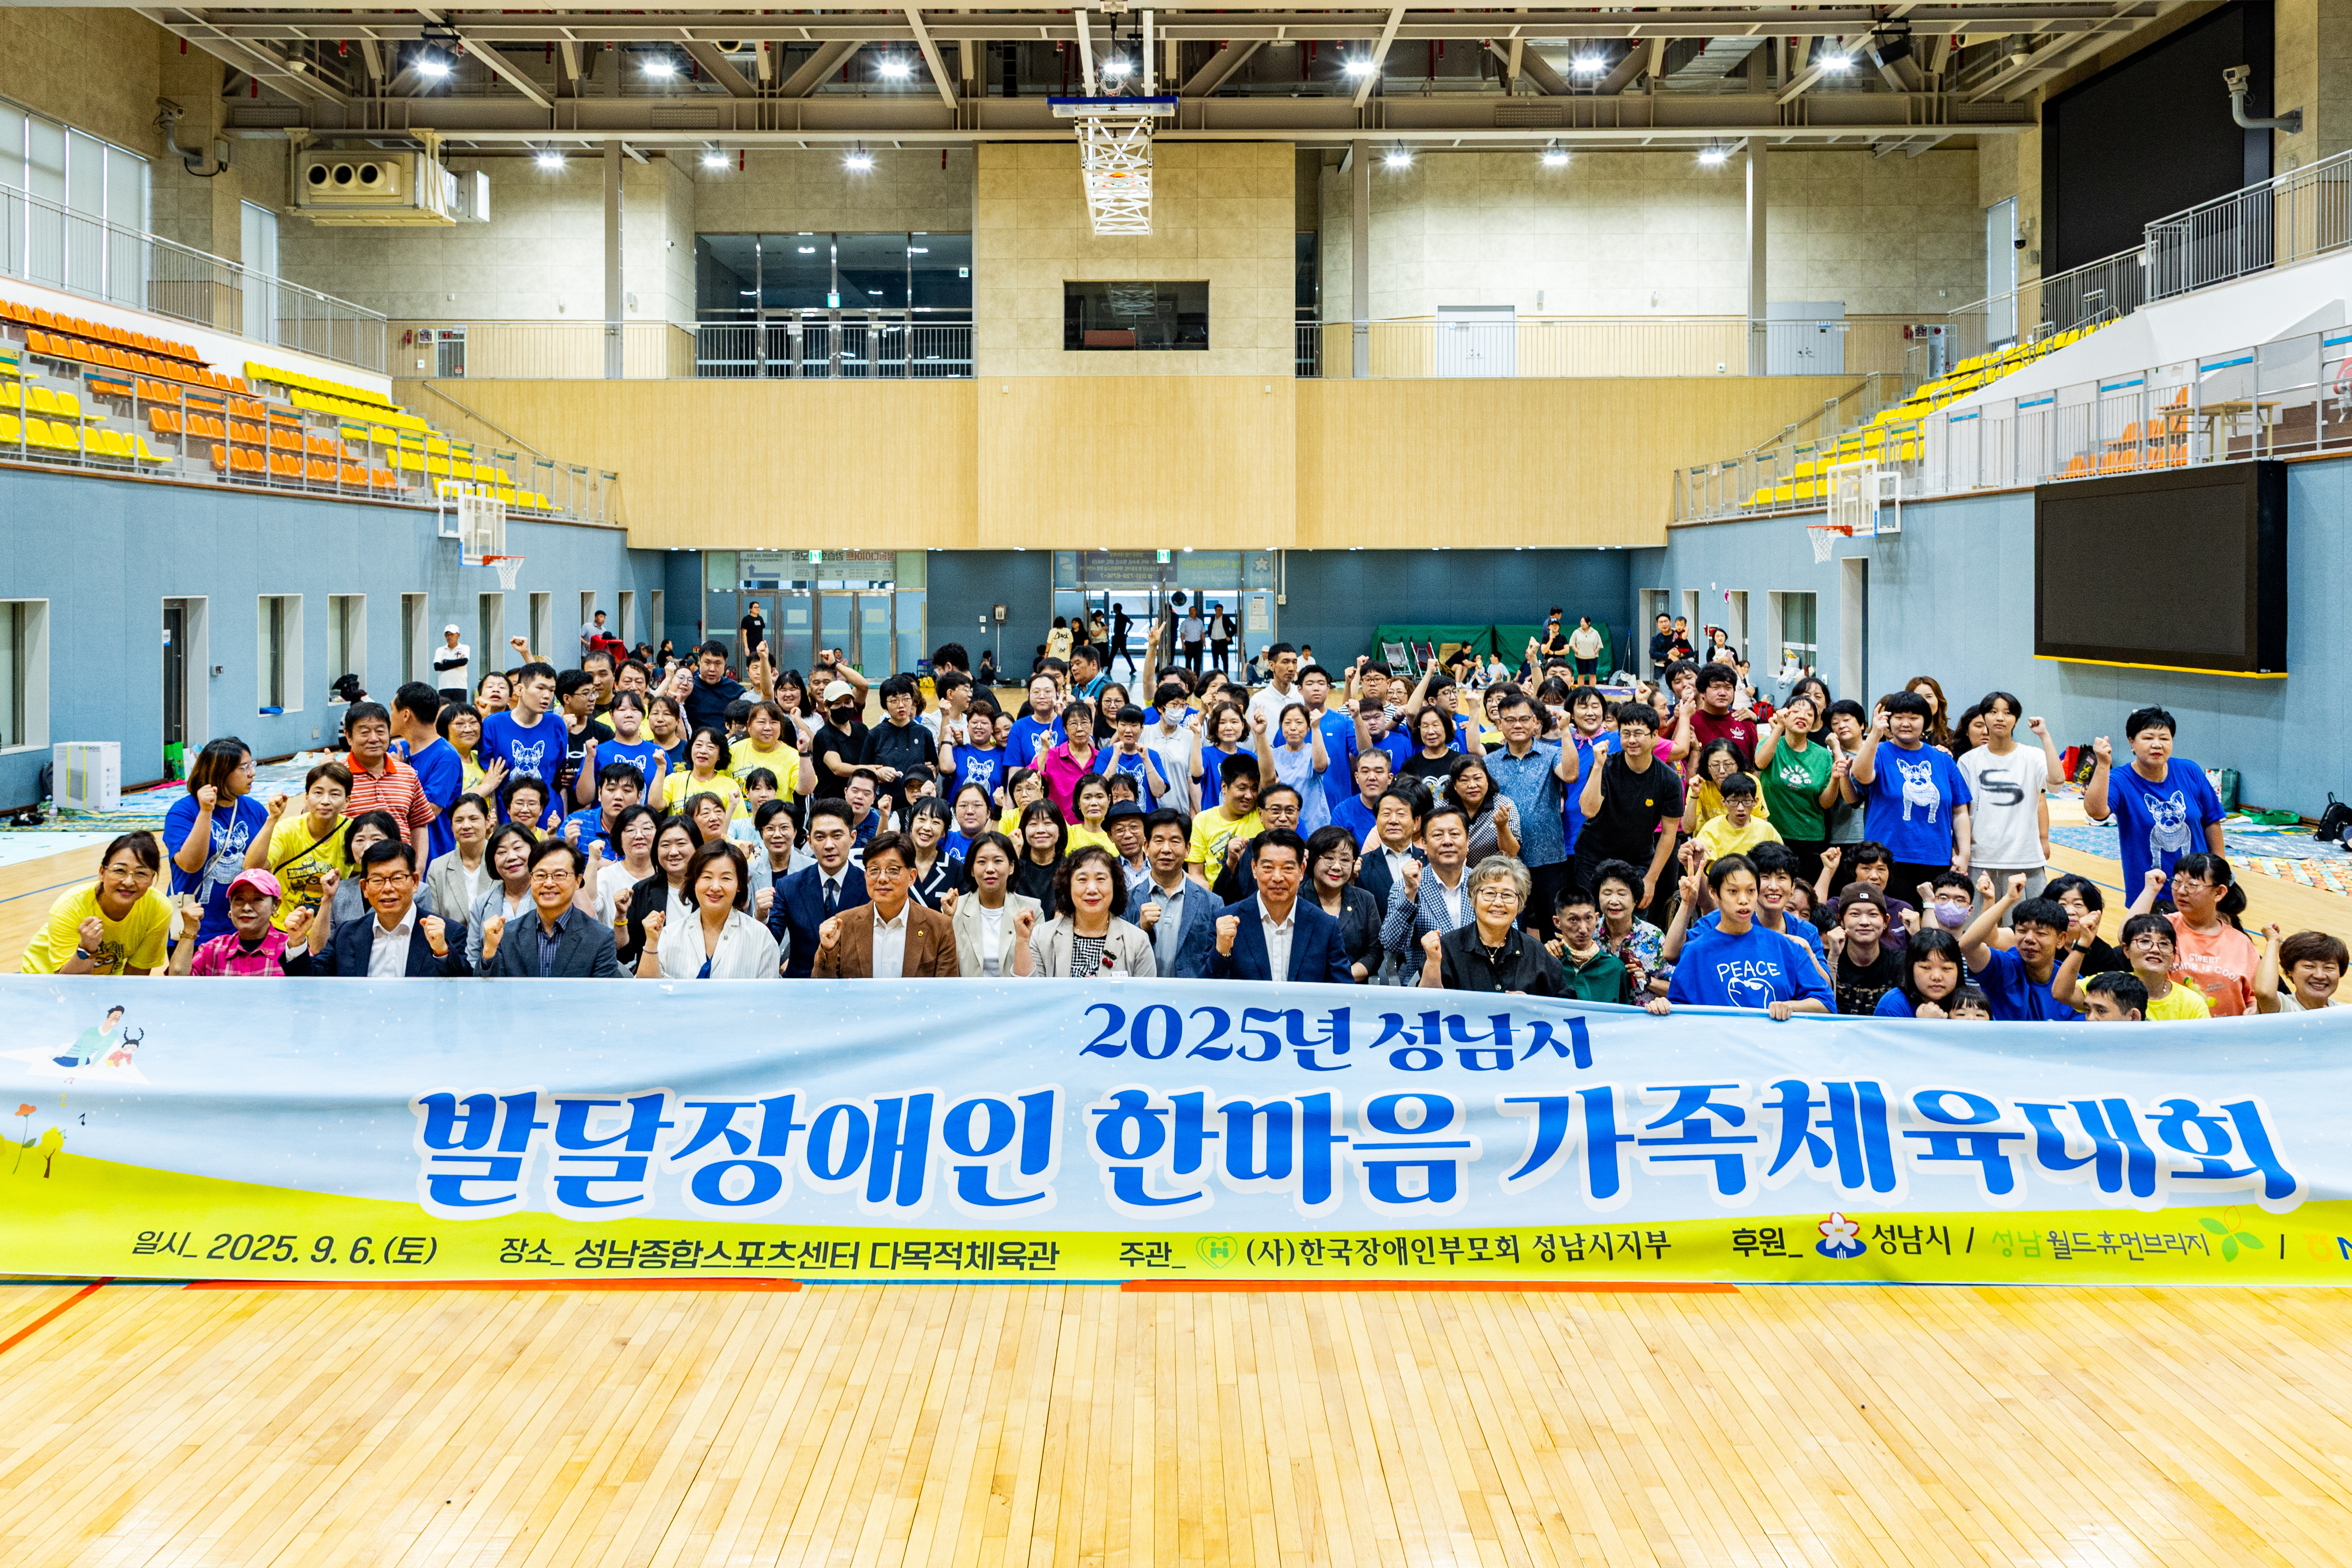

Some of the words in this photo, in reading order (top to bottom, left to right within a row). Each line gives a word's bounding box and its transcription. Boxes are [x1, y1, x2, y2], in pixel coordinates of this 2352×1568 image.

[1717, 960, 1781, 982] PEACE
[2189, 953, 2221, 963] SWEET
[1080, 1003, 1352, 1071] 2025년
[1369, 1010, 1593, 1071] 성남시
[418, 1090, 1055, 1208] 발달장애인
[1091, 1090, 1471, 1206] 한마음
[1504, 1080, 2296, 1200] 가족체육대회
[132, 1231, 197, 1257] 일시_
[207, 1234, 298, 1263] 2025.
[311, 1236, 337, 1264] 9.
[349, 1236, 437, 1265] 6.(토)
[500, 1238, 565, 1265] 장소_
[575, 1239, 860, 1269] 성남종합스포츠센터
[870, 1241, 1060, 1271] 다목적체육관
[1119, 1242, 1186, 1270] 주관_
[1247, 1235, 1519, 1267] (사)한국장애인부모회
[1533, 1231, 1672, 1263] 성남시지부
[1732, 1228, 1803, 1258] 후원_
[1872, 1224, 1951, 1255] 성남시
